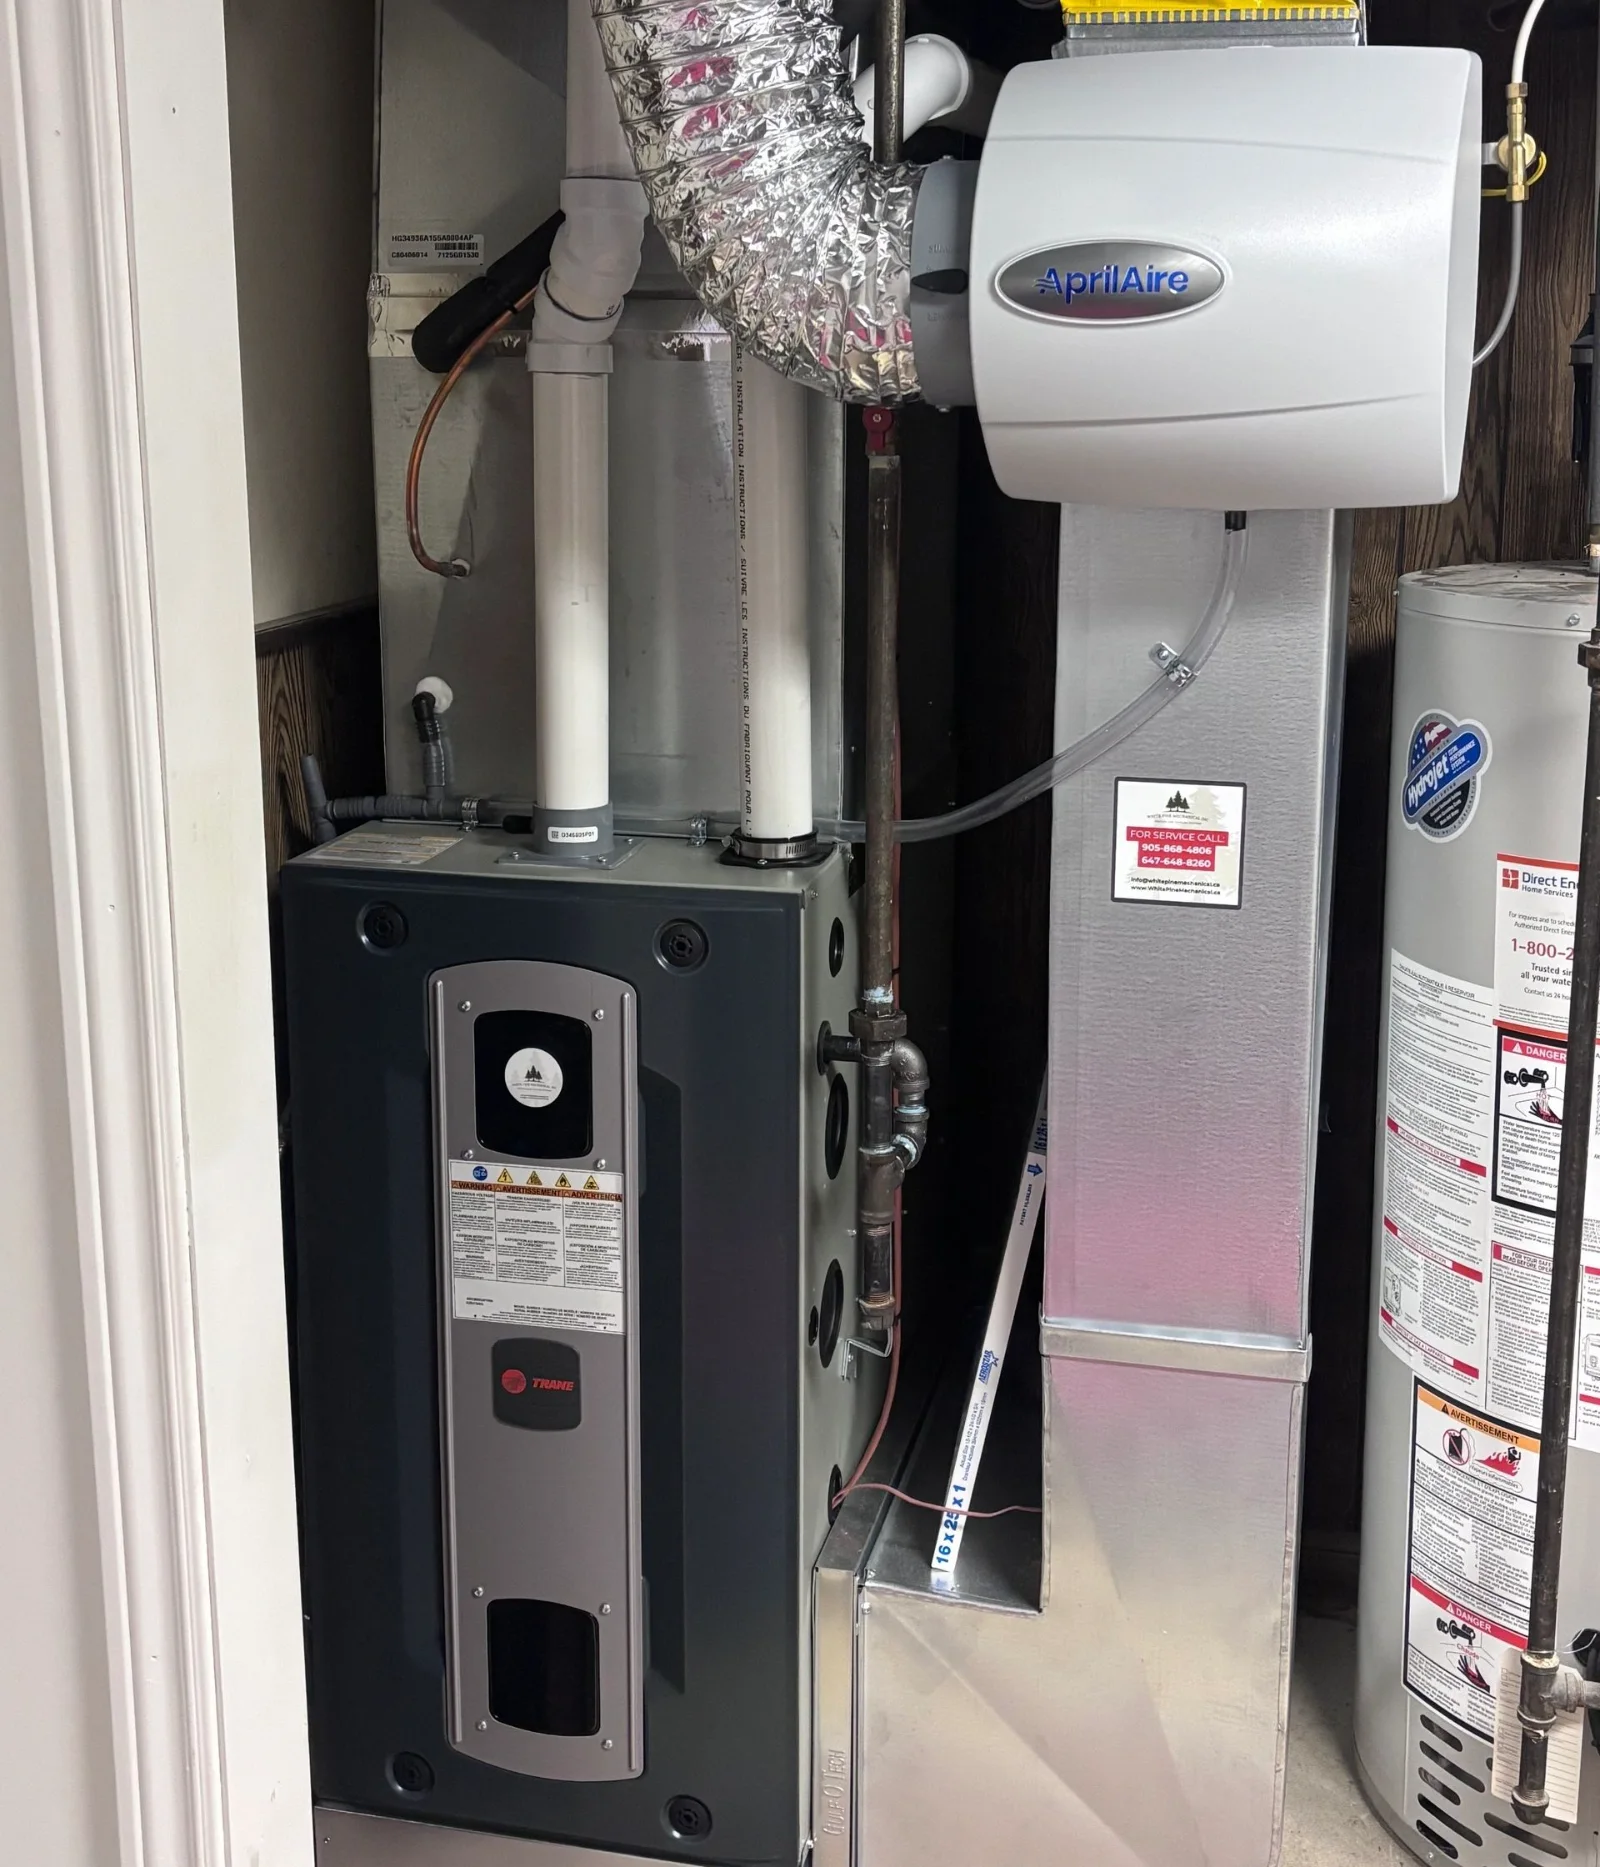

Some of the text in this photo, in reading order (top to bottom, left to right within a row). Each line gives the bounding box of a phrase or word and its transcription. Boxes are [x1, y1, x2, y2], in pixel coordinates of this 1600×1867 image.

[1034, 264, 1188, 304] AprilAire
[736, 380, 744, 458] INSTALLATION
[738, 464, 746, 540] INSTRUCTIONS
[740, 558, 748, 596] SUIVRE
[742, 627, 750, 700] INSTRUCTIONS
[743, 705, 750, 719] DU
[1408, 755, 1449, 808] Hydrojet
[1130, 829, 1151, 839] FOR
[1153, 831, 1196, 841] SERVICE
[1141, 843, 1212, 854] 905-868-4806
[1141, 856, 1211, 868] 647-648-8260
[1522, 871, 1578, 889] Direct En
[1522, 885, 1574, 898] Home Services
[1543, 926, 1559, 934] Direct
[1531, 962, 1560, 975] Trusted
[1521, 971, 1529, 979] all
[1532, 974, 1549, 982] your
[1524, 987, 1544, 997] Contact
[1526, 1045, 1567, 1062] DANGER
[459, 1181, 493, 1191] WARNING
[502, 1186, 561, 1197] AVERTISSEMENT
[571, 1191, 623, 1203] ADVERTENCIA
[979, 1349, 993, 1385] AEROSTAR
[532, 1378, 575, 1391] TRANE
[1450, 1408, 1520, 1445] AVERTISSEMENT
[936, 1484, 966, 1565] 16 x 25 x 1
[1456, 1608, 1492, 1633] DANGER
